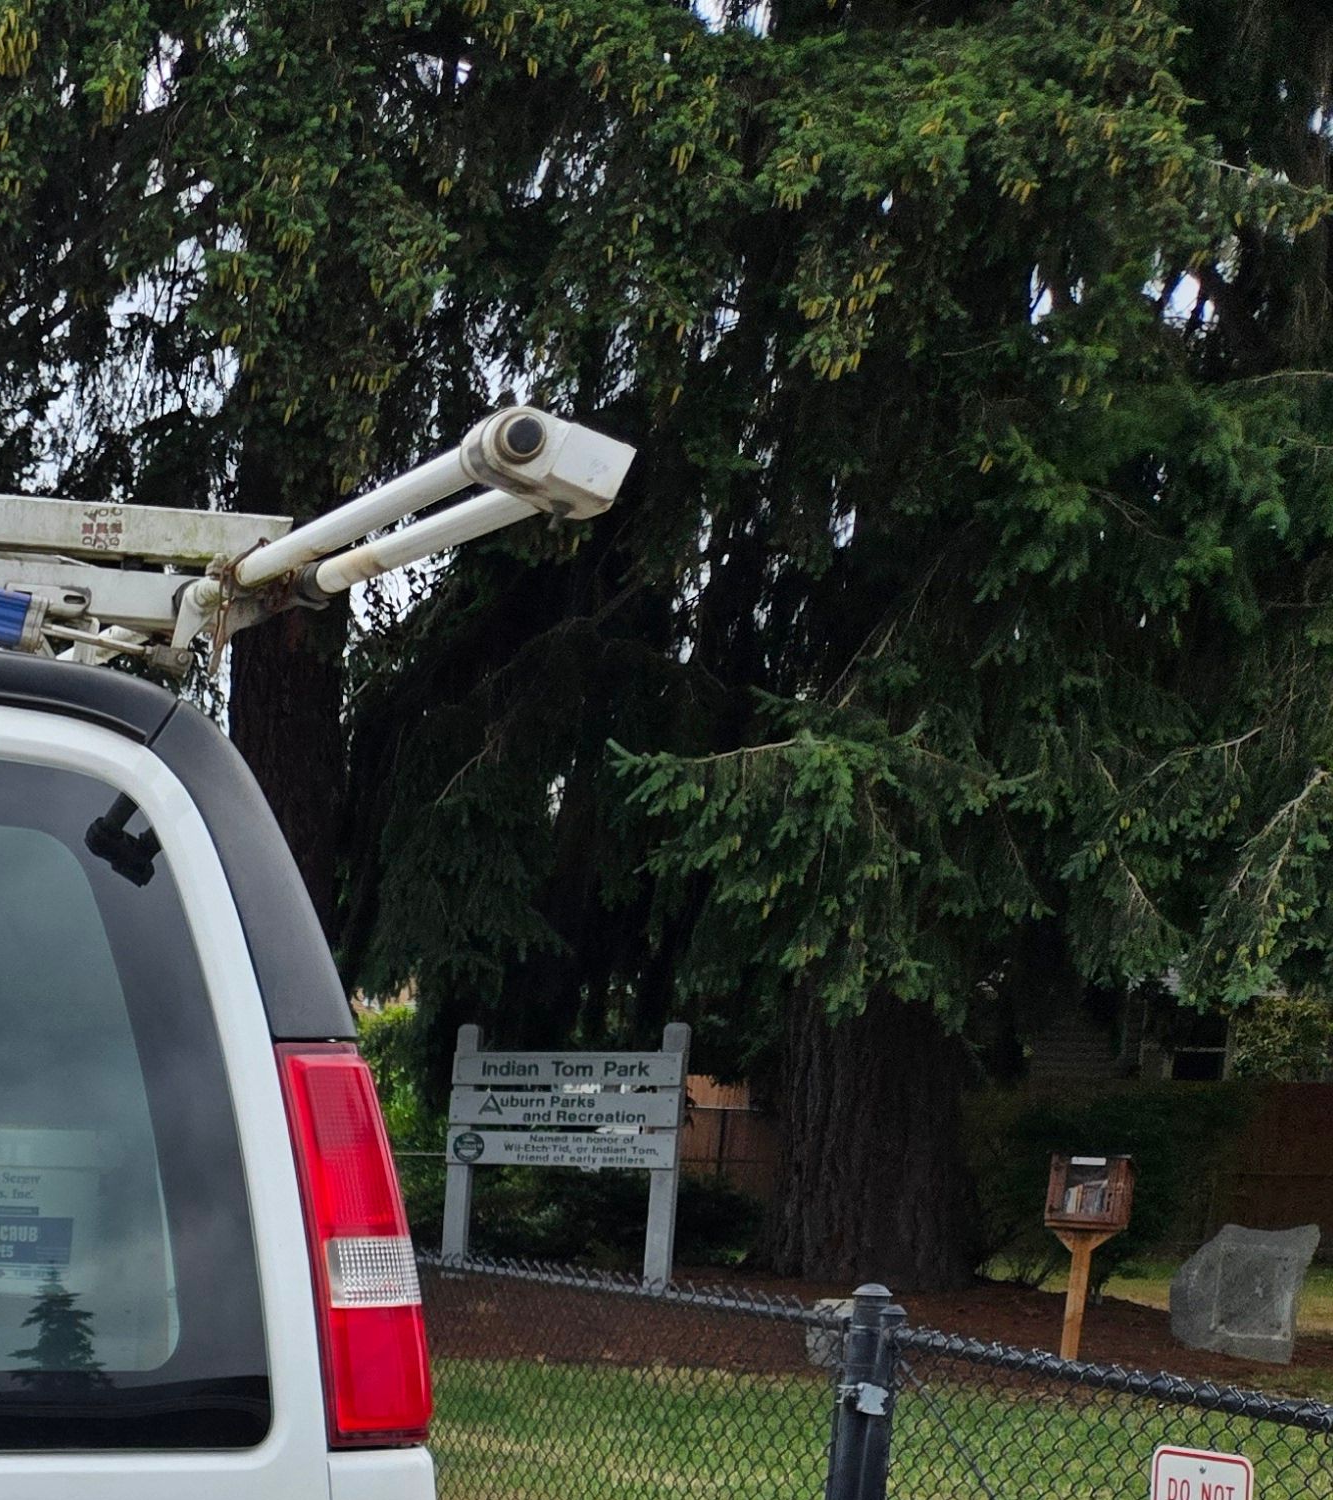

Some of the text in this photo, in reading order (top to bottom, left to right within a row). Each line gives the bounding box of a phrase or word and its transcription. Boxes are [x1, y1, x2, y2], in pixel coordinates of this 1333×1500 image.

[482, 1060, 650, 1077] Indian Tom Park
[478, 1094, 595, 1116] Auburn Parks
[522, 1110, 646, 1124] and Recreation
[529, 1134, 635, 1144] Named in honor of
[576, 1146, 588, 1154] or
[591, 1145, 626, 1154] Indian
[631, 1146, 659, 1156] Tom,
[517, 1153, 645, 1165] friend of early settlers
